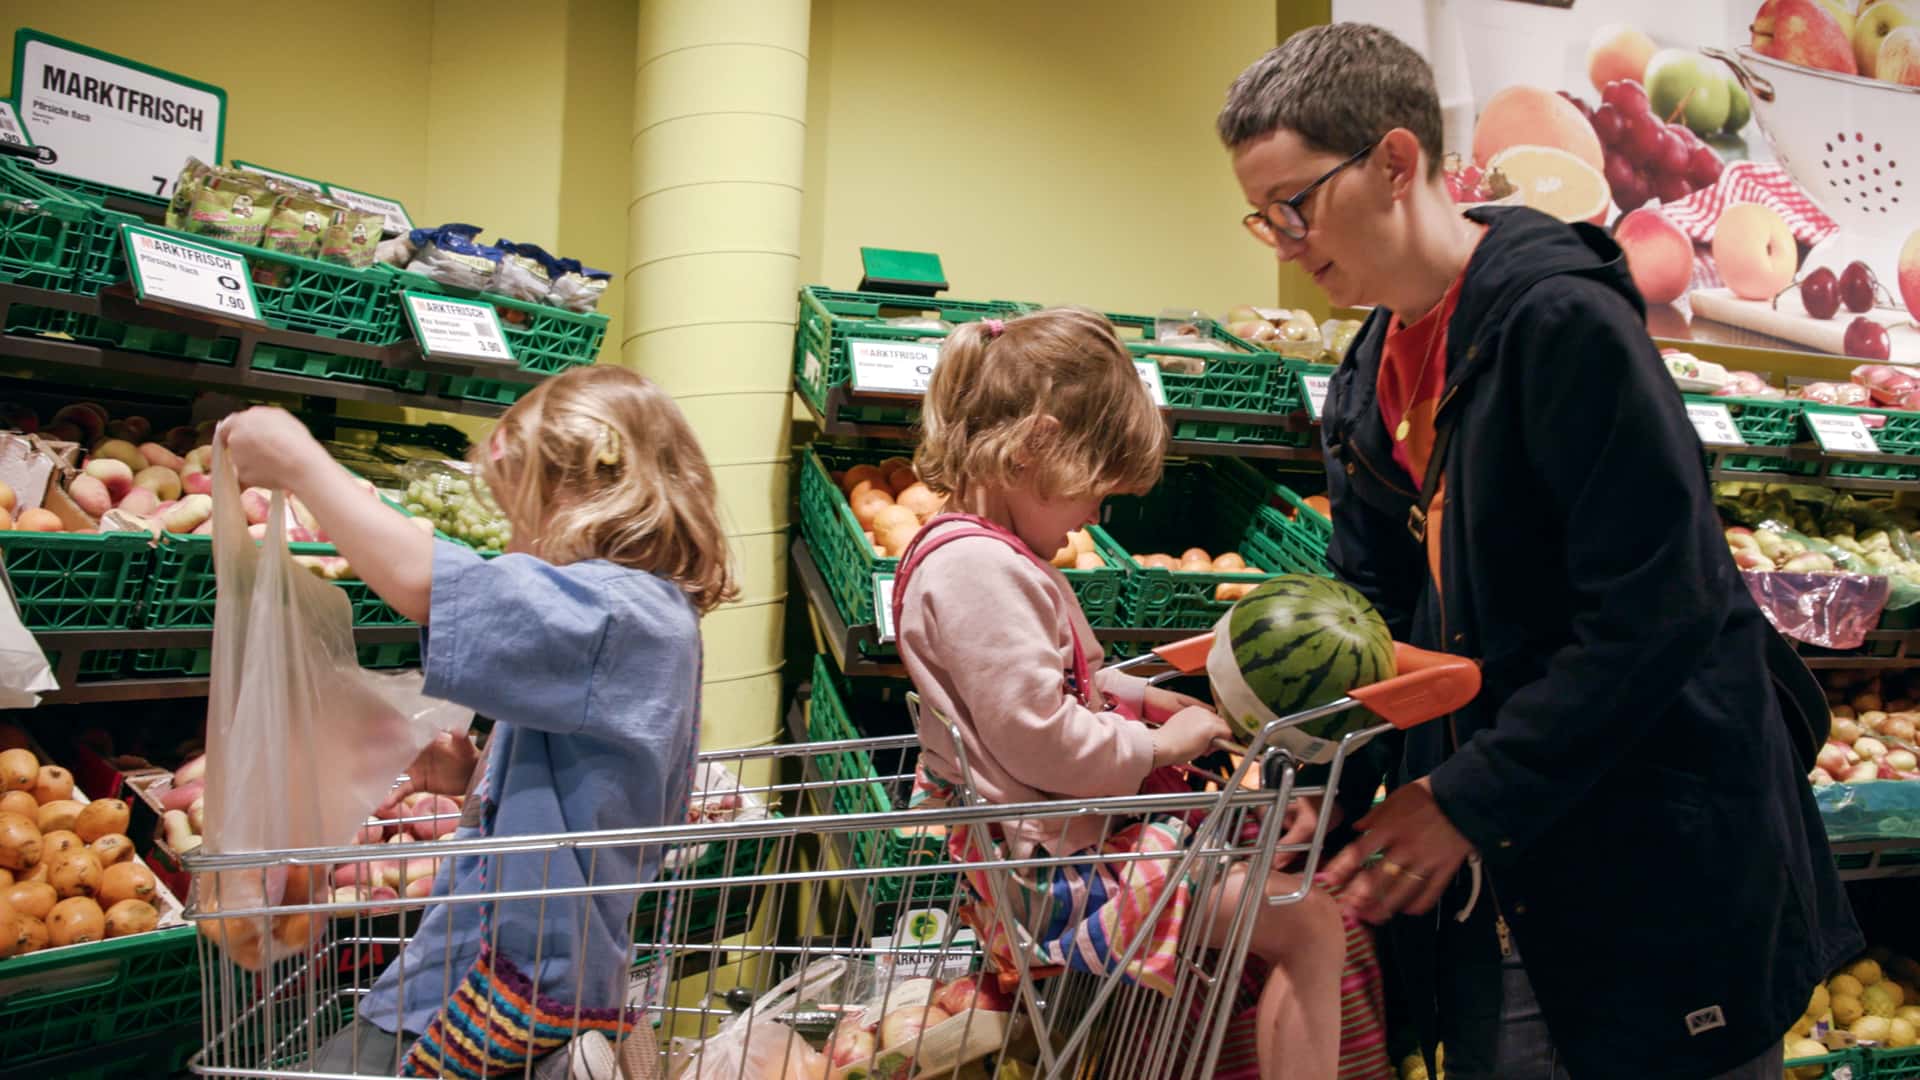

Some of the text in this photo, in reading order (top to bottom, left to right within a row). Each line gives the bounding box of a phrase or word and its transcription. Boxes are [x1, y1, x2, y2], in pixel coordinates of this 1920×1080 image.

[42, 64, 205, 133] MARKTFRISCH
[142, 238, 233, 271] MARKTFRISCH
[216, 293, 246, 311] 7.90
[416, 301, 486, 319] MARKTFRISCH
[859, 348, 928, 361] MARKTFRISCH
